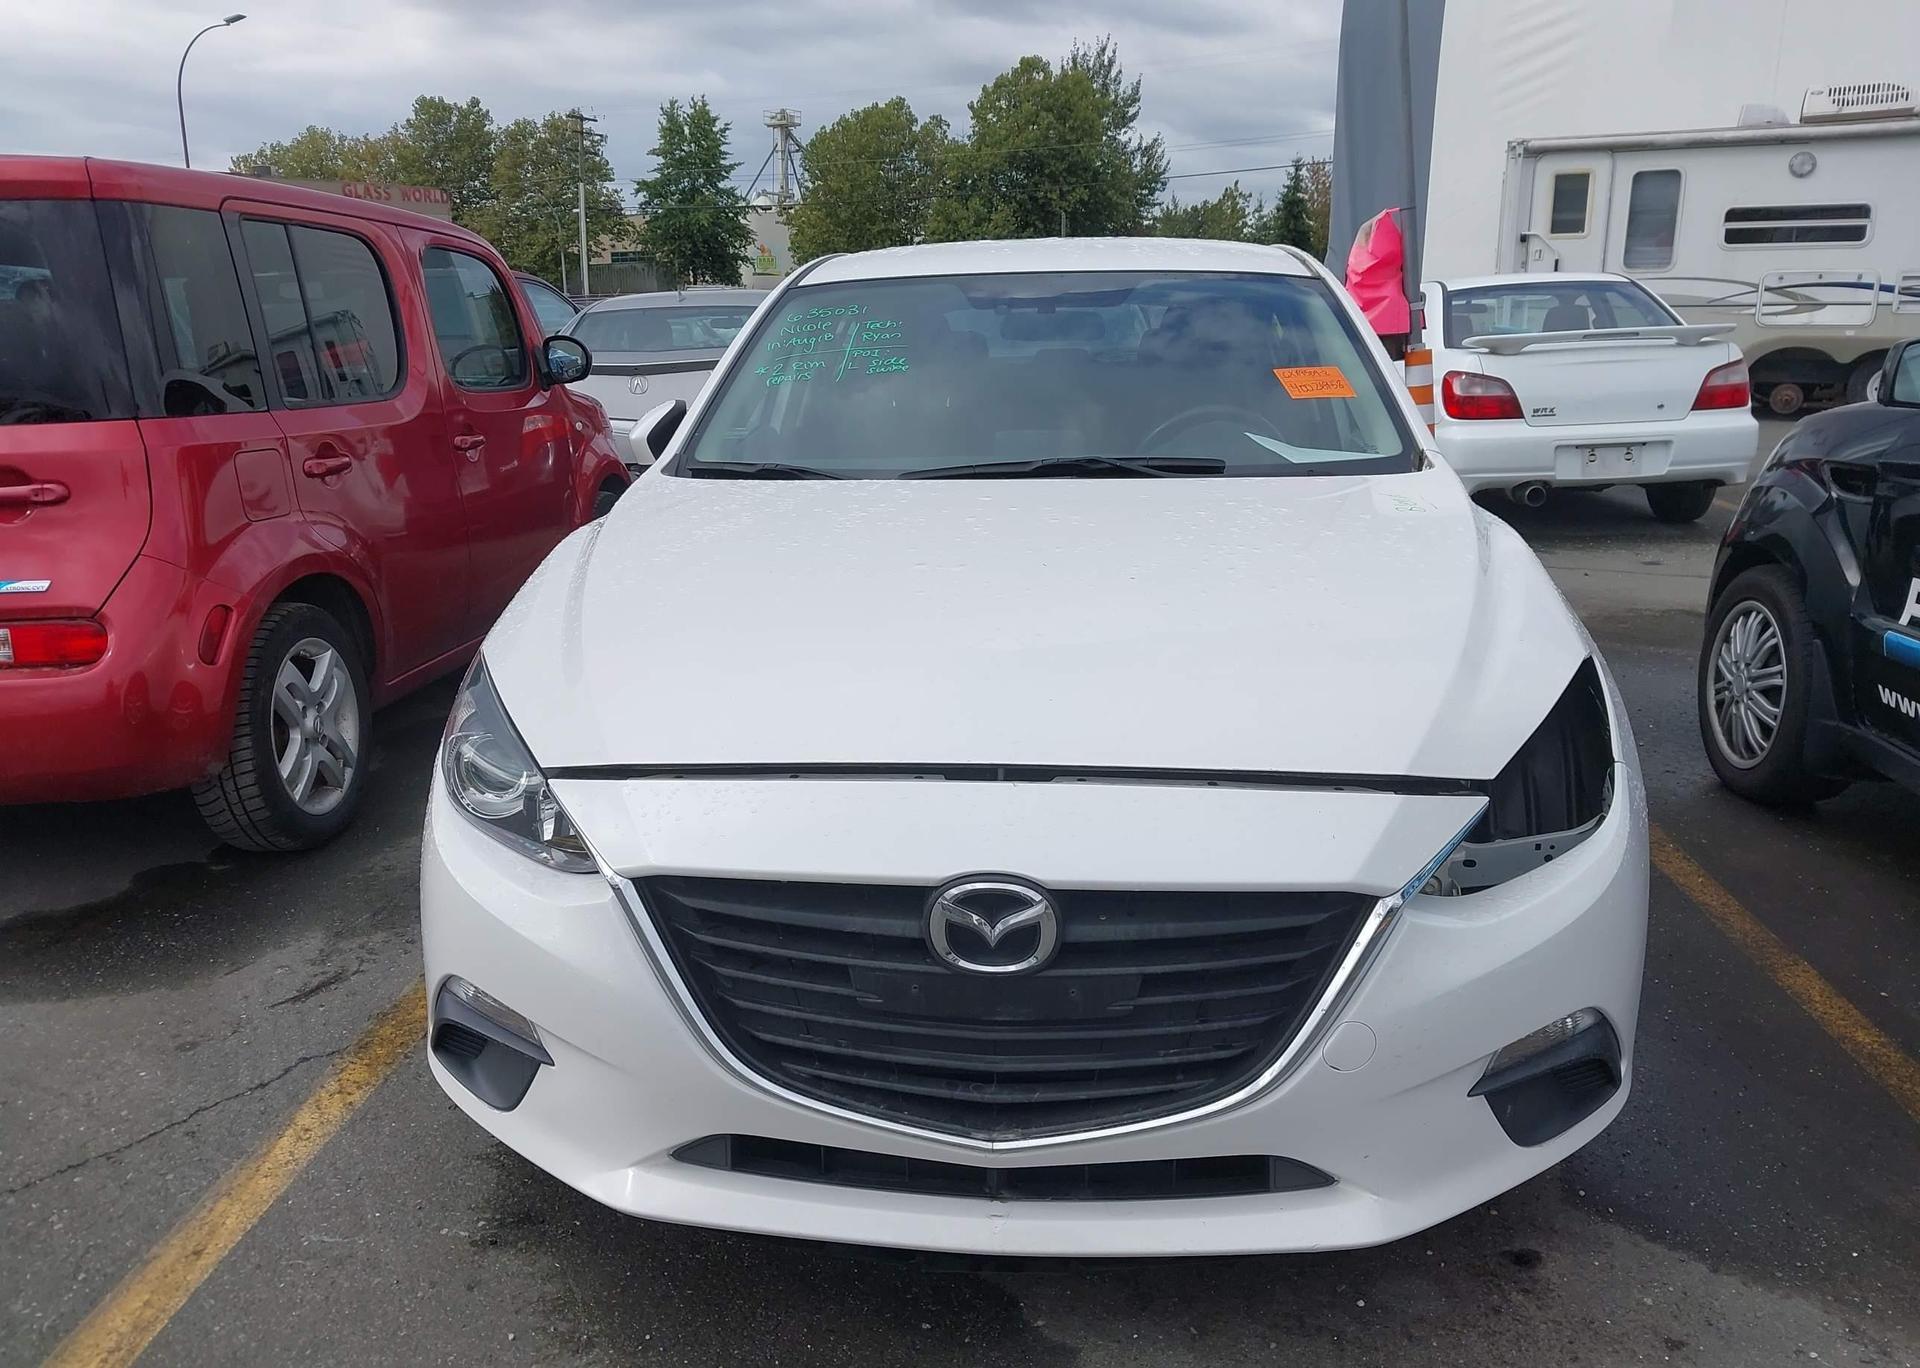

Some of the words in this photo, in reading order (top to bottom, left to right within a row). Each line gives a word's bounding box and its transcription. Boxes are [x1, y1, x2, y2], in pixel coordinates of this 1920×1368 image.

[342, 183, 391, 200] GLASS
[400, 187, 450, 204] WORLD
[780, 321, 832, 335] Nicole
[861, 332, 901, 342] Ryan
[766, 371, 813, 386] repairs
